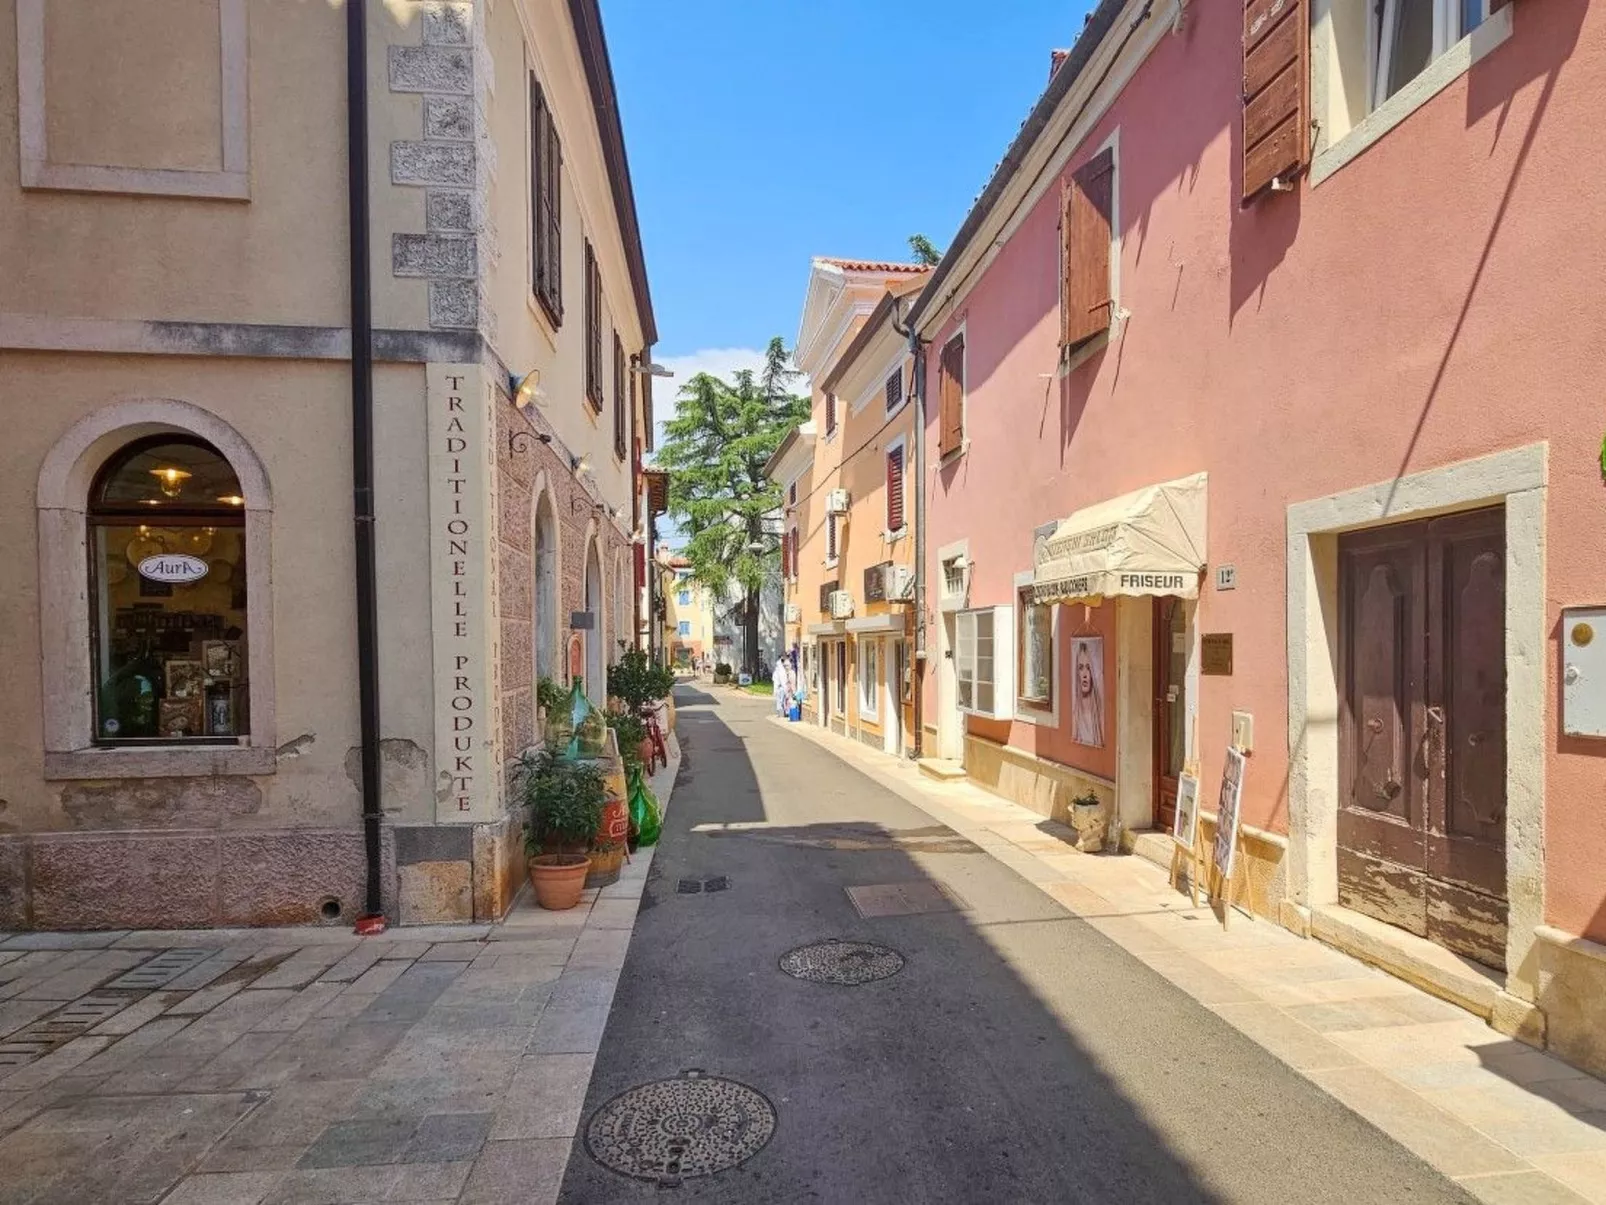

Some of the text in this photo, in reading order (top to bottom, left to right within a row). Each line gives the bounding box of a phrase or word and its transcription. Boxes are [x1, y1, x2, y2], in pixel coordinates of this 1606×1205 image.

[445, 375, 474, 813] TRADITIONELLE PRODUKTE
[1120, 574, 1183, 588] FRISEUR
